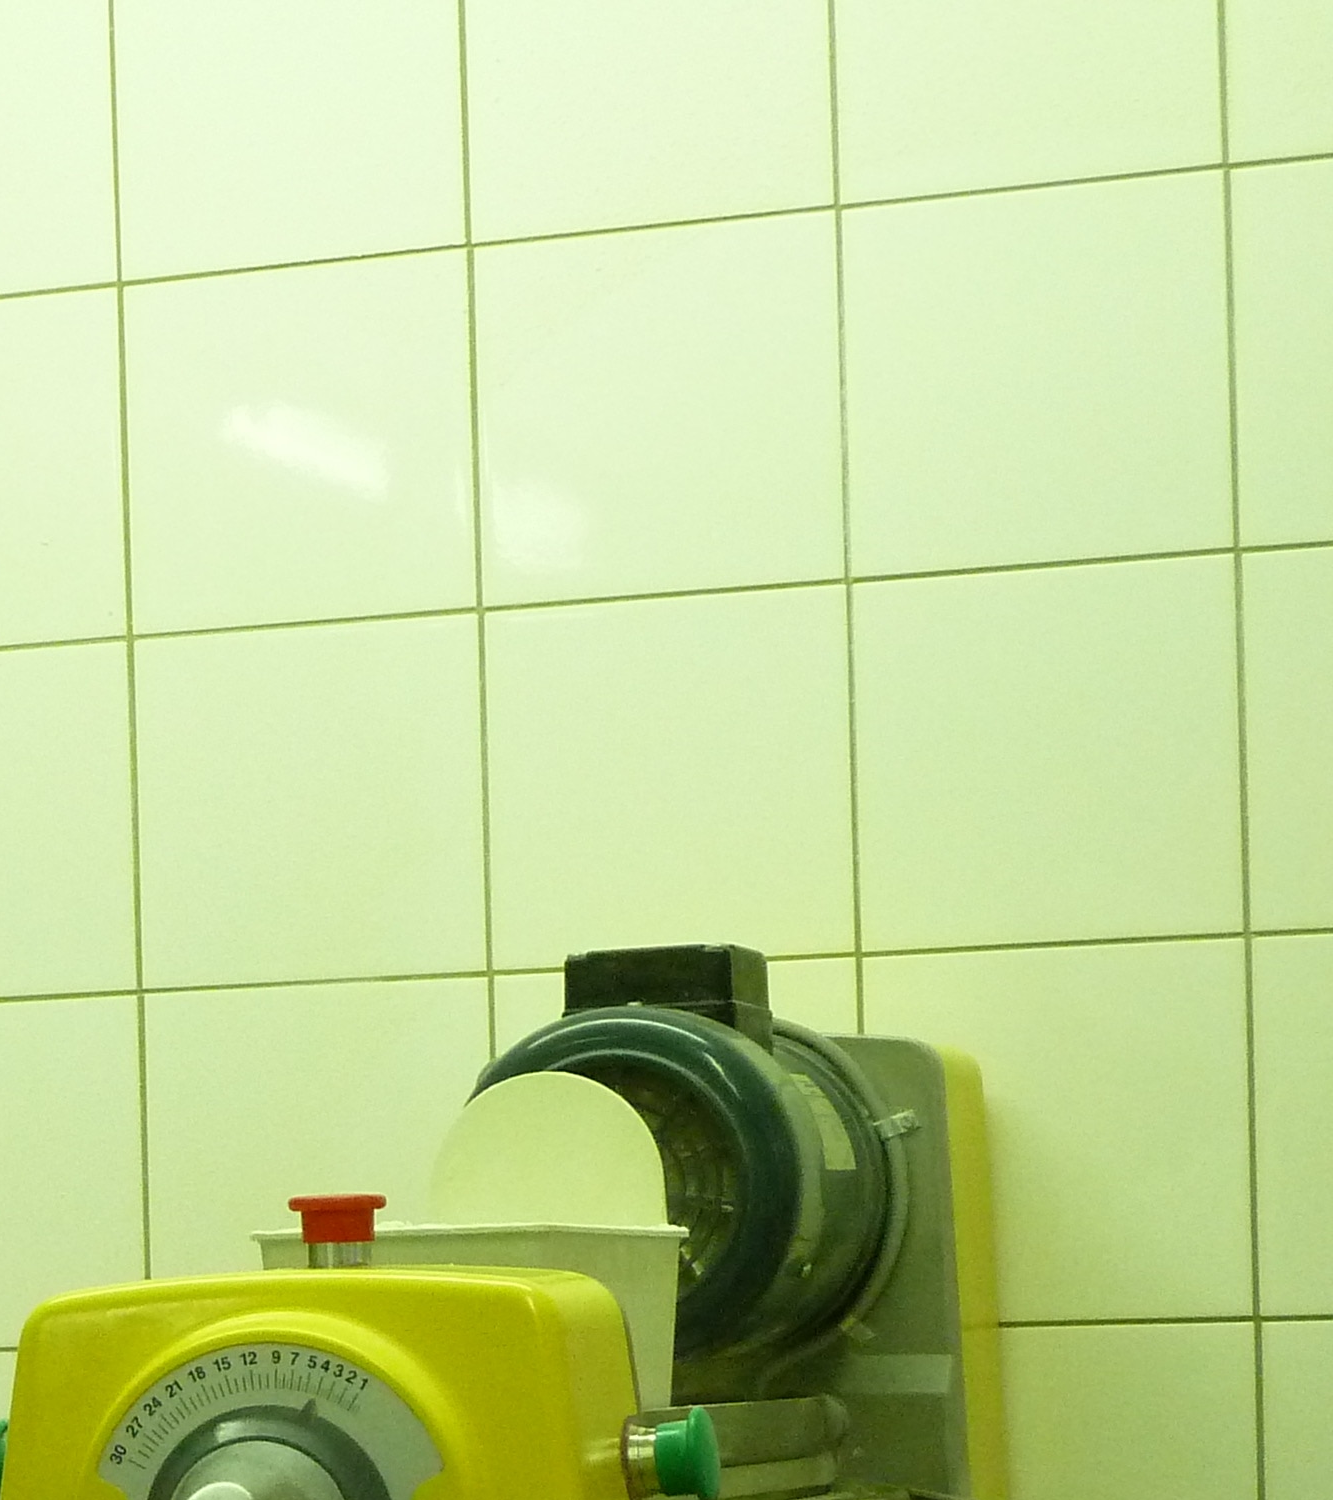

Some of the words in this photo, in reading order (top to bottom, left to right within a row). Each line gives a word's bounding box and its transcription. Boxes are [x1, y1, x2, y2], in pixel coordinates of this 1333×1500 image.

[110, 1444, 127, 1465] 30
[126, 1416, 143, 1439] 27
[143, 1396, 163, 1417] 24
[165, 1380, 183, 1399] 21
[188, 1366, 206, 1382] 18
[213, 1356, 231, 1372] 15
[240, 1351, 257, 1366] 12
[272, 1350, 281, 1364] 9
[290, 1351, 300, 1366] 7
[307, 1355, 317, 1369] 5
[320, 1359, 331, 1373] 4
[333, 1363, 344, 1378] 3
[345, 1370, 358, 1385] 2
[359, 1377, 369, 1391] 1
